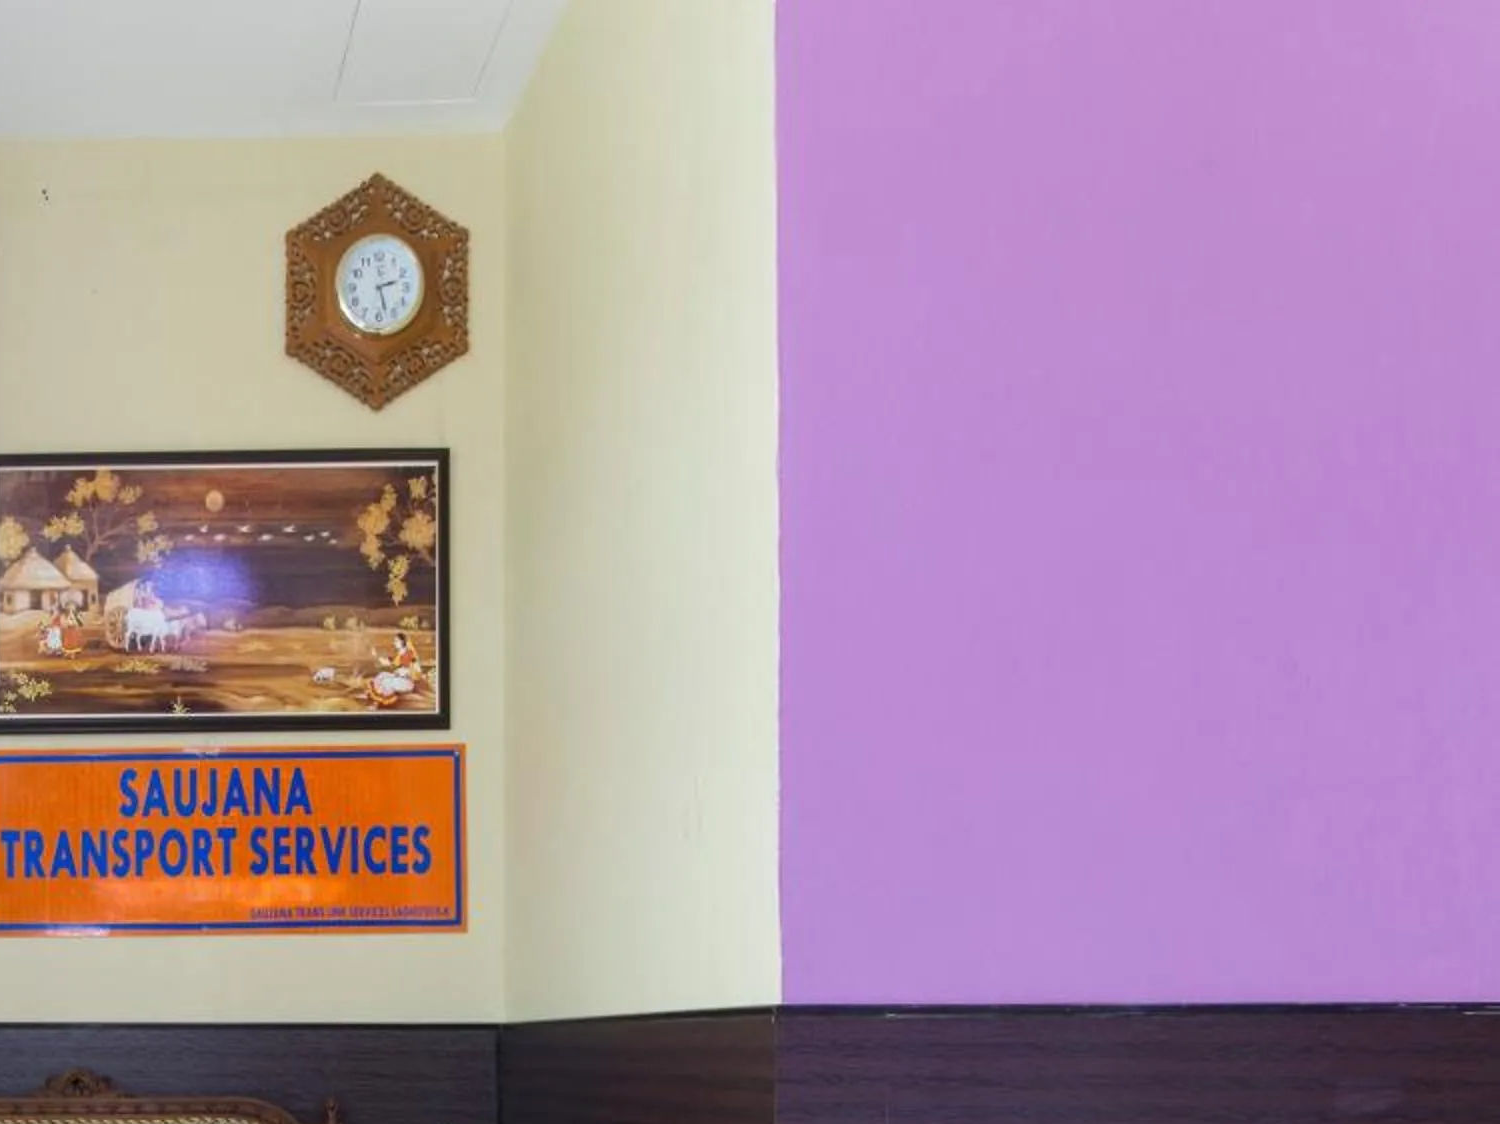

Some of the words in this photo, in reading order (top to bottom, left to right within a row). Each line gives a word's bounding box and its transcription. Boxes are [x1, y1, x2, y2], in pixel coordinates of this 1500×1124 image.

[119, 767, 312, 818] SAUJANA
[0, 827, 238, 879] TRANSPORT
[250, 825, 432, 876] SERVICES
